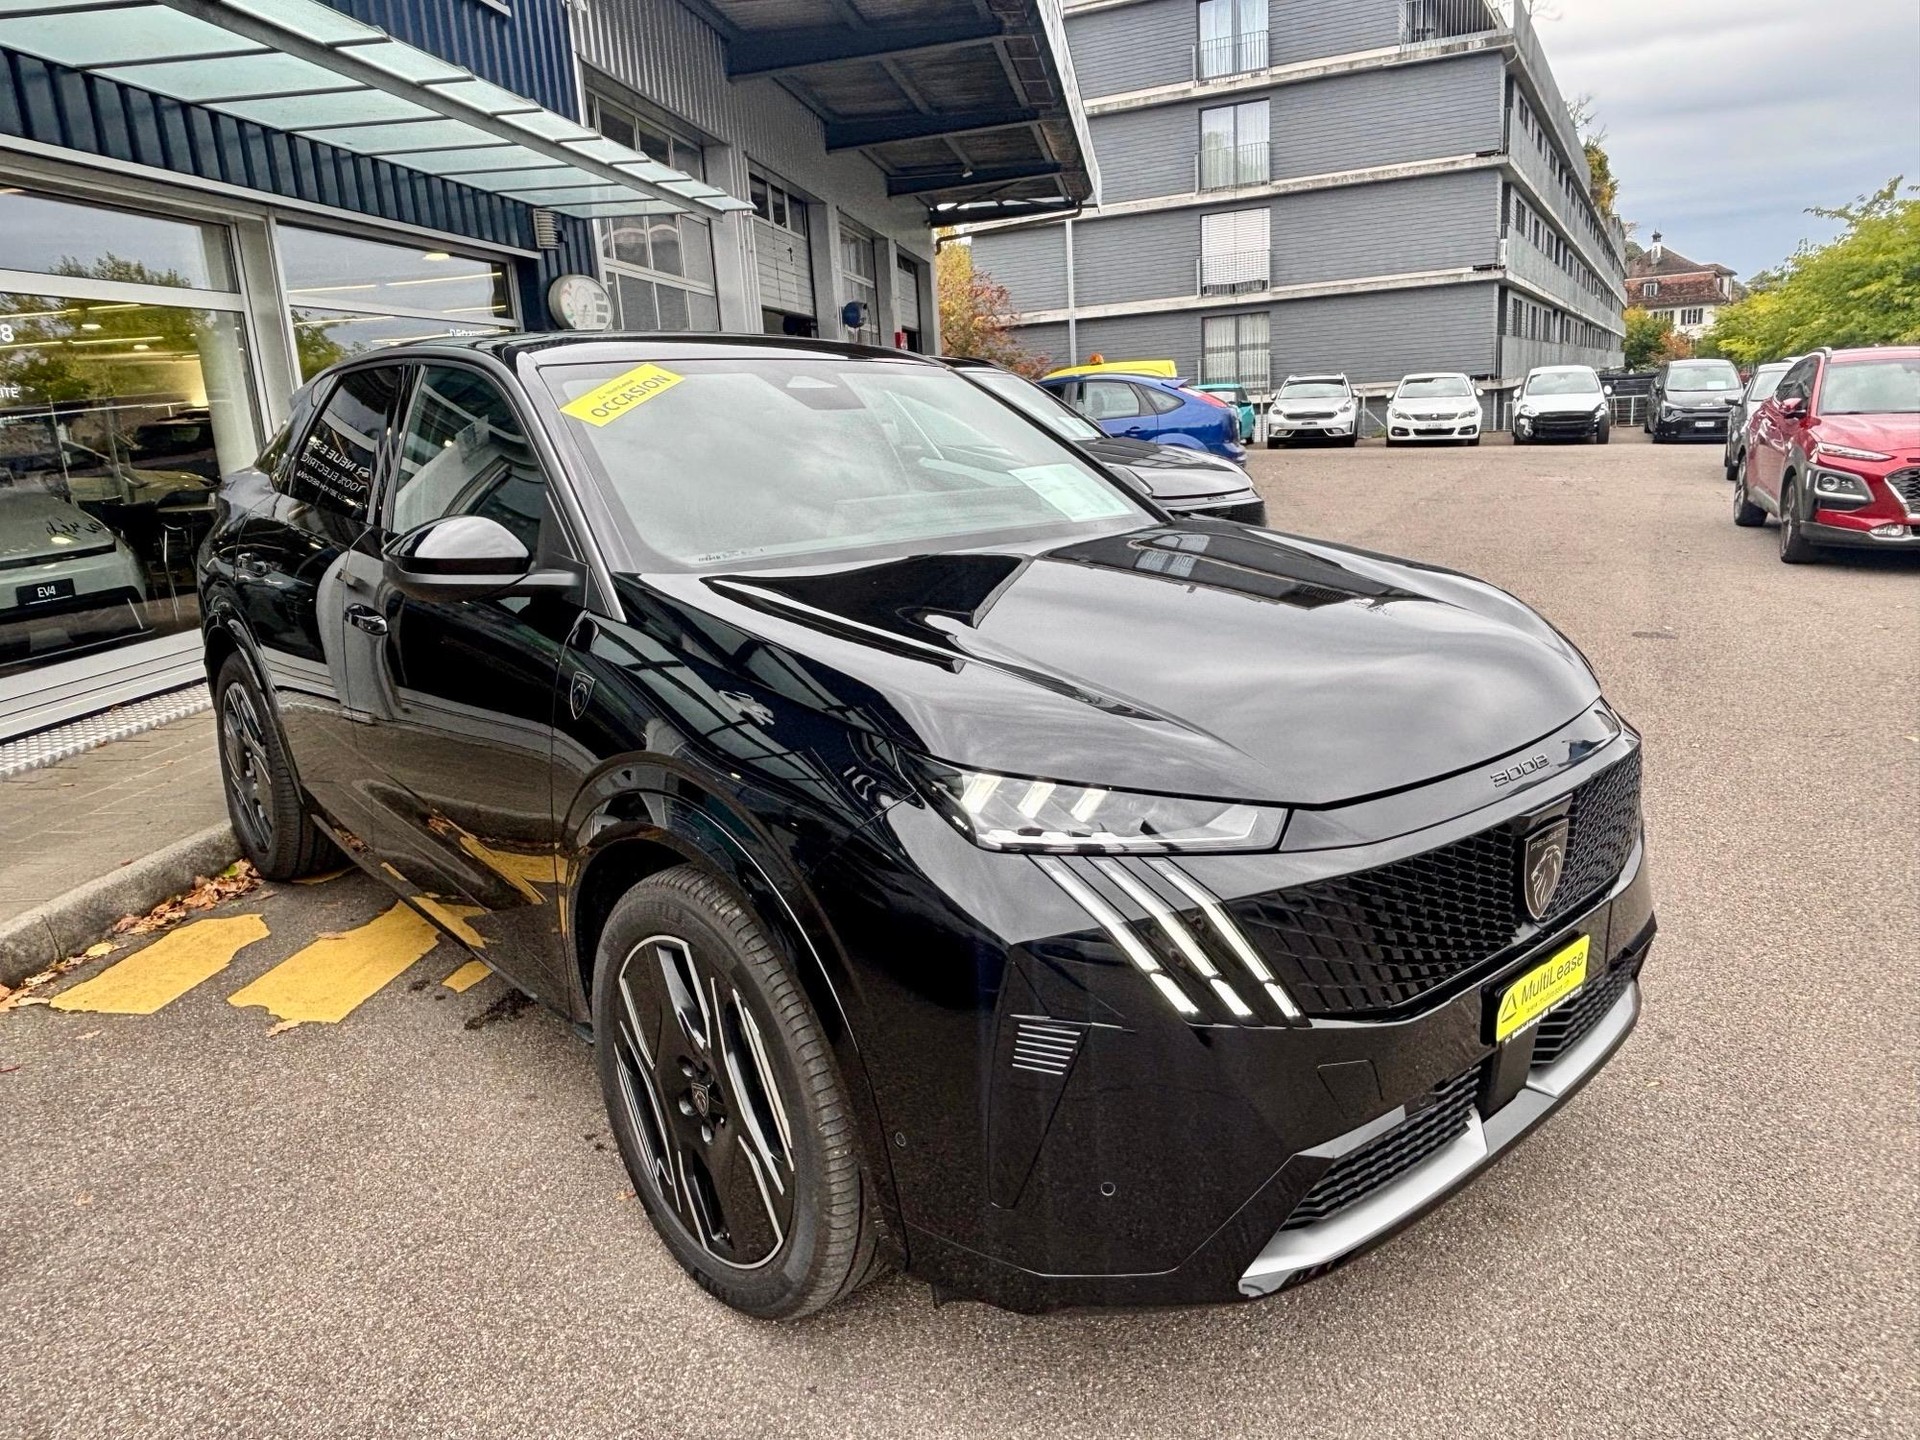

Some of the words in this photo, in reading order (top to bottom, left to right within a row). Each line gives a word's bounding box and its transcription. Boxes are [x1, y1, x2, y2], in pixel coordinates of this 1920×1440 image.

[0, 387, 20, 398] ITE
[591, 374, 671, 418] OCCASION
[37, 585, 56, 597] EV4
[1490, 753, 1549, 788] 3008
[1521, 951, 1584, 1005] MultiLease
